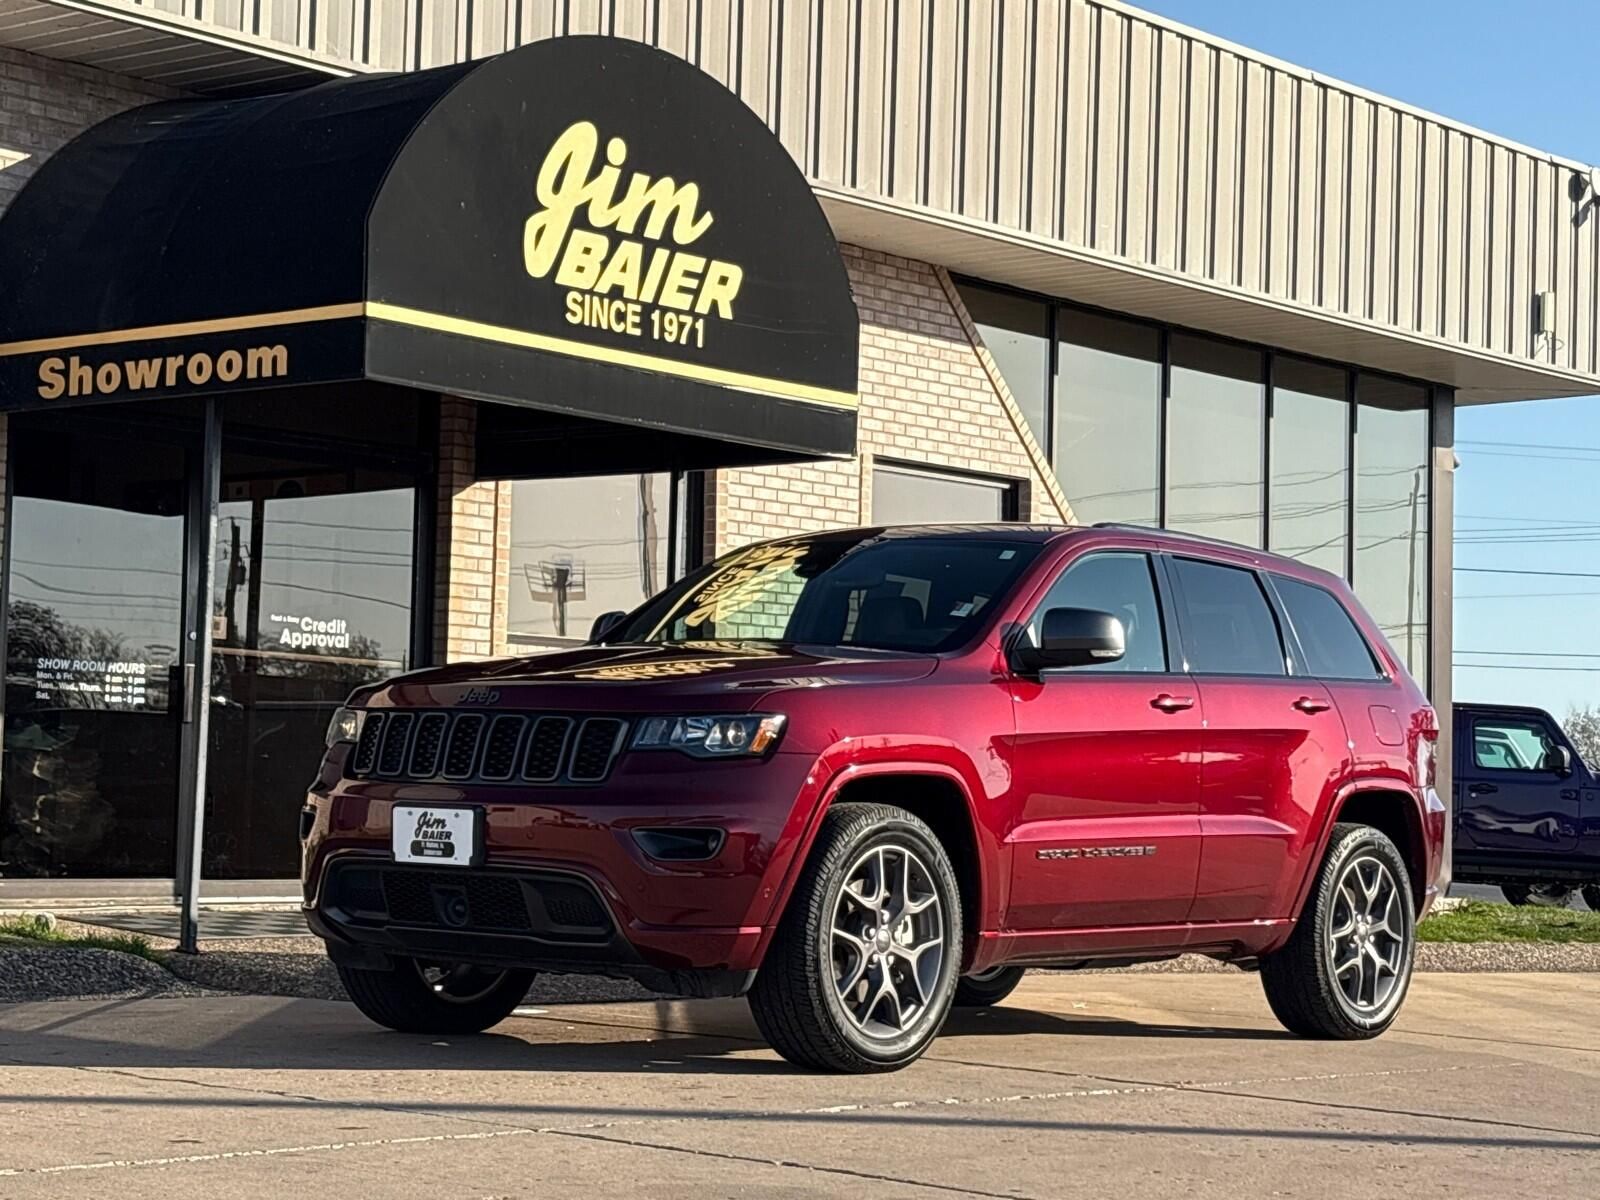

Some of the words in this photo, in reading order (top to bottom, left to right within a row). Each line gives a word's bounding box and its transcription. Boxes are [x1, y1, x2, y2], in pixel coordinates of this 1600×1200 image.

[523, 120, 714, 278] Jim
[554, 228, 743, 320] BAIER
[565, 290, 642, 336] SINCE
[651, 309, 705, 348] 1971
[38, 344, 288, 399] Showroom
[300, 616, 347, 634] Credit
[279, 627, 350, 649] Approval
[37, 658, 71, 670] SHOW
[72, 660, 106, 672] ROOM
[107, 662, 146, 675] HOURS
[460, 687, 500, 705] Jeep
[414, 811, 447, 838] Jim
[421, 830, 453, 840] BAIER
